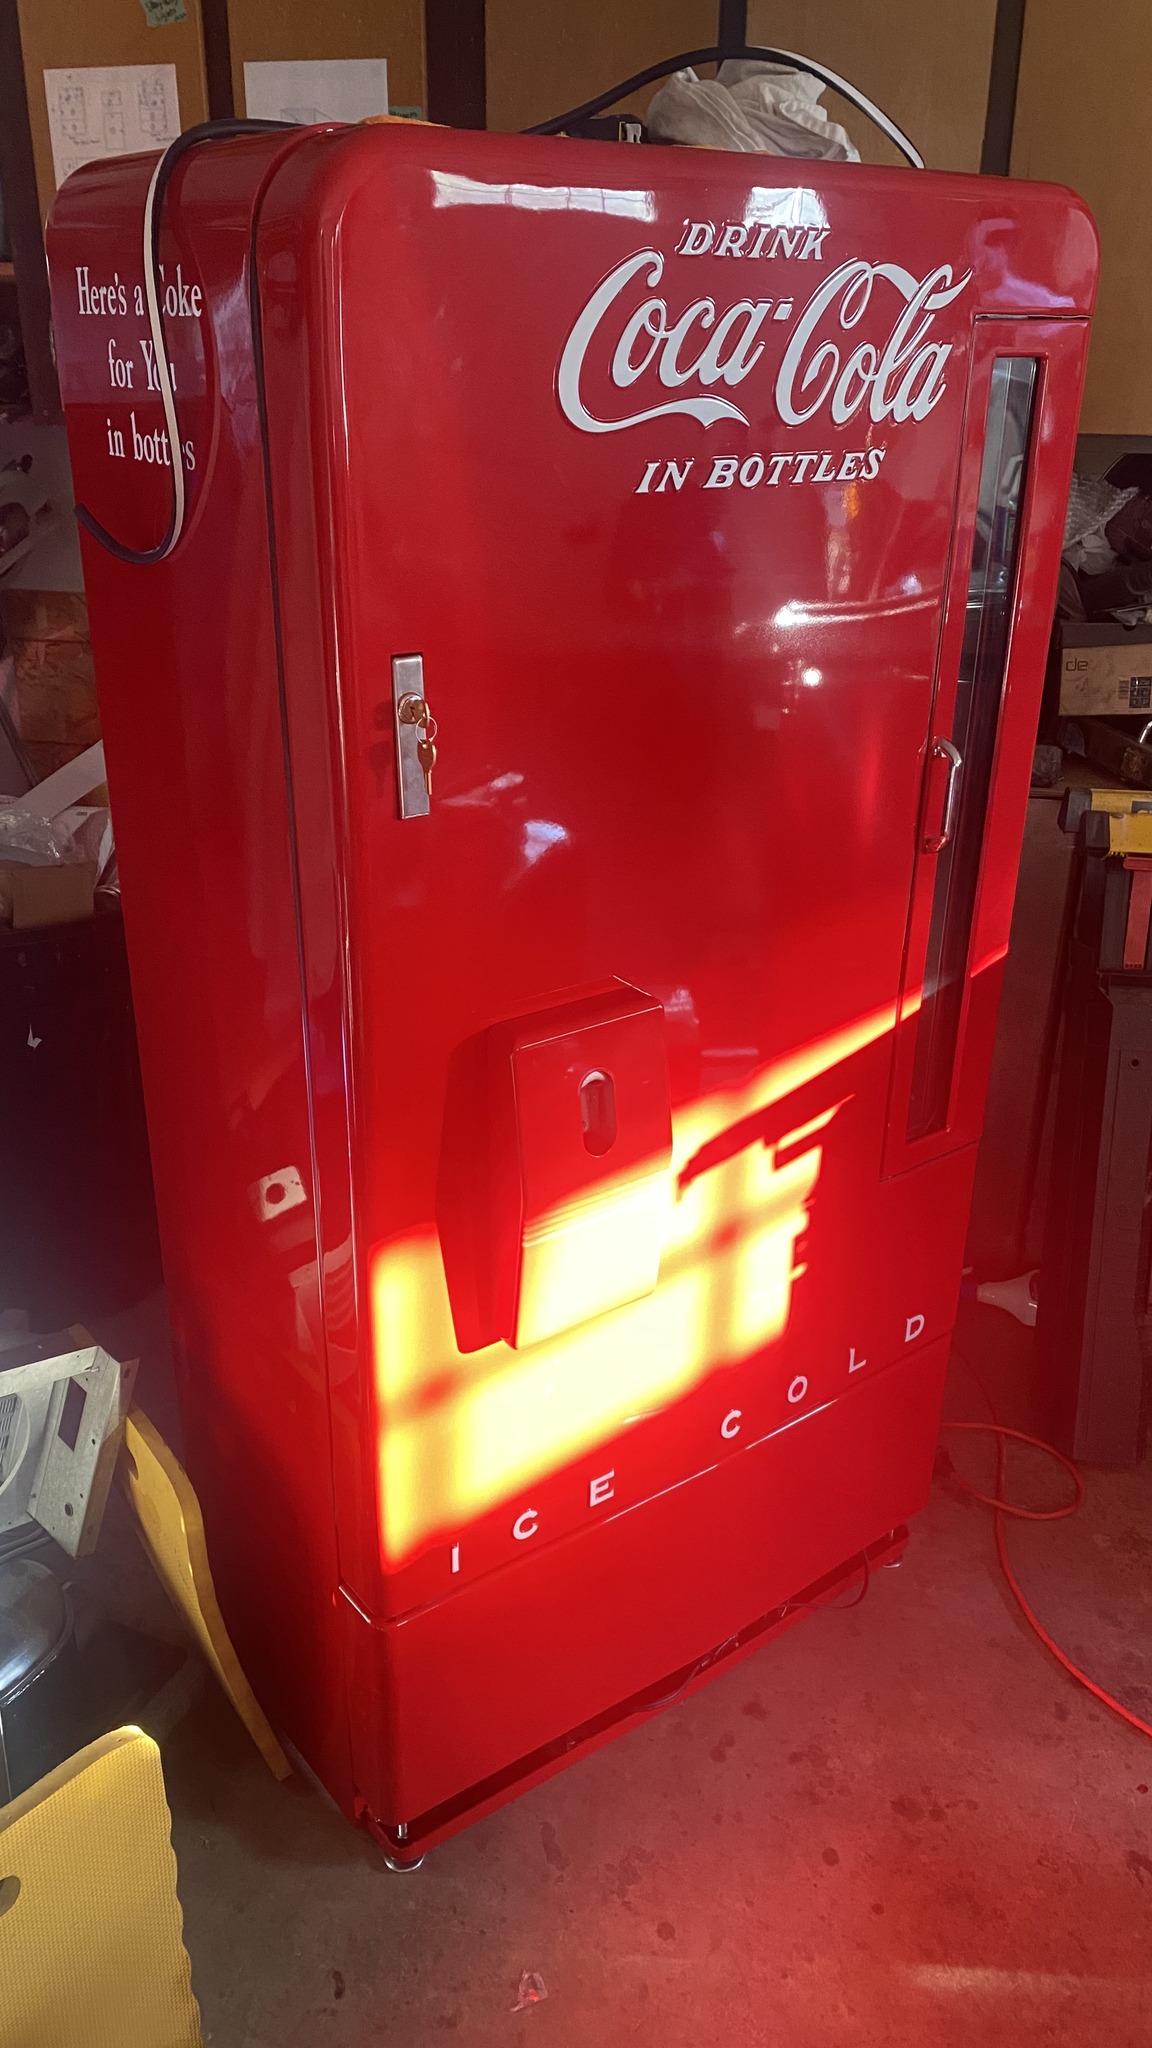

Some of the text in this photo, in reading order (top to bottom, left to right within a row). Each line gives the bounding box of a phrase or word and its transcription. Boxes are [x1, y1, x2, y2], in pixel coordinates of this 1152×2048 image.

[676, 220, 831, 261] DRINK
[75, 263, 202, 317] Here's a oke
[108, 338, 133, 389] for
[556, 248, 973, 434] Coca-Cola
[107, 410, 196, 471] in botts
[634, 446, 887, 494] IN BOTTLES
[451, 1313, 925, 1574] ICE COLD
